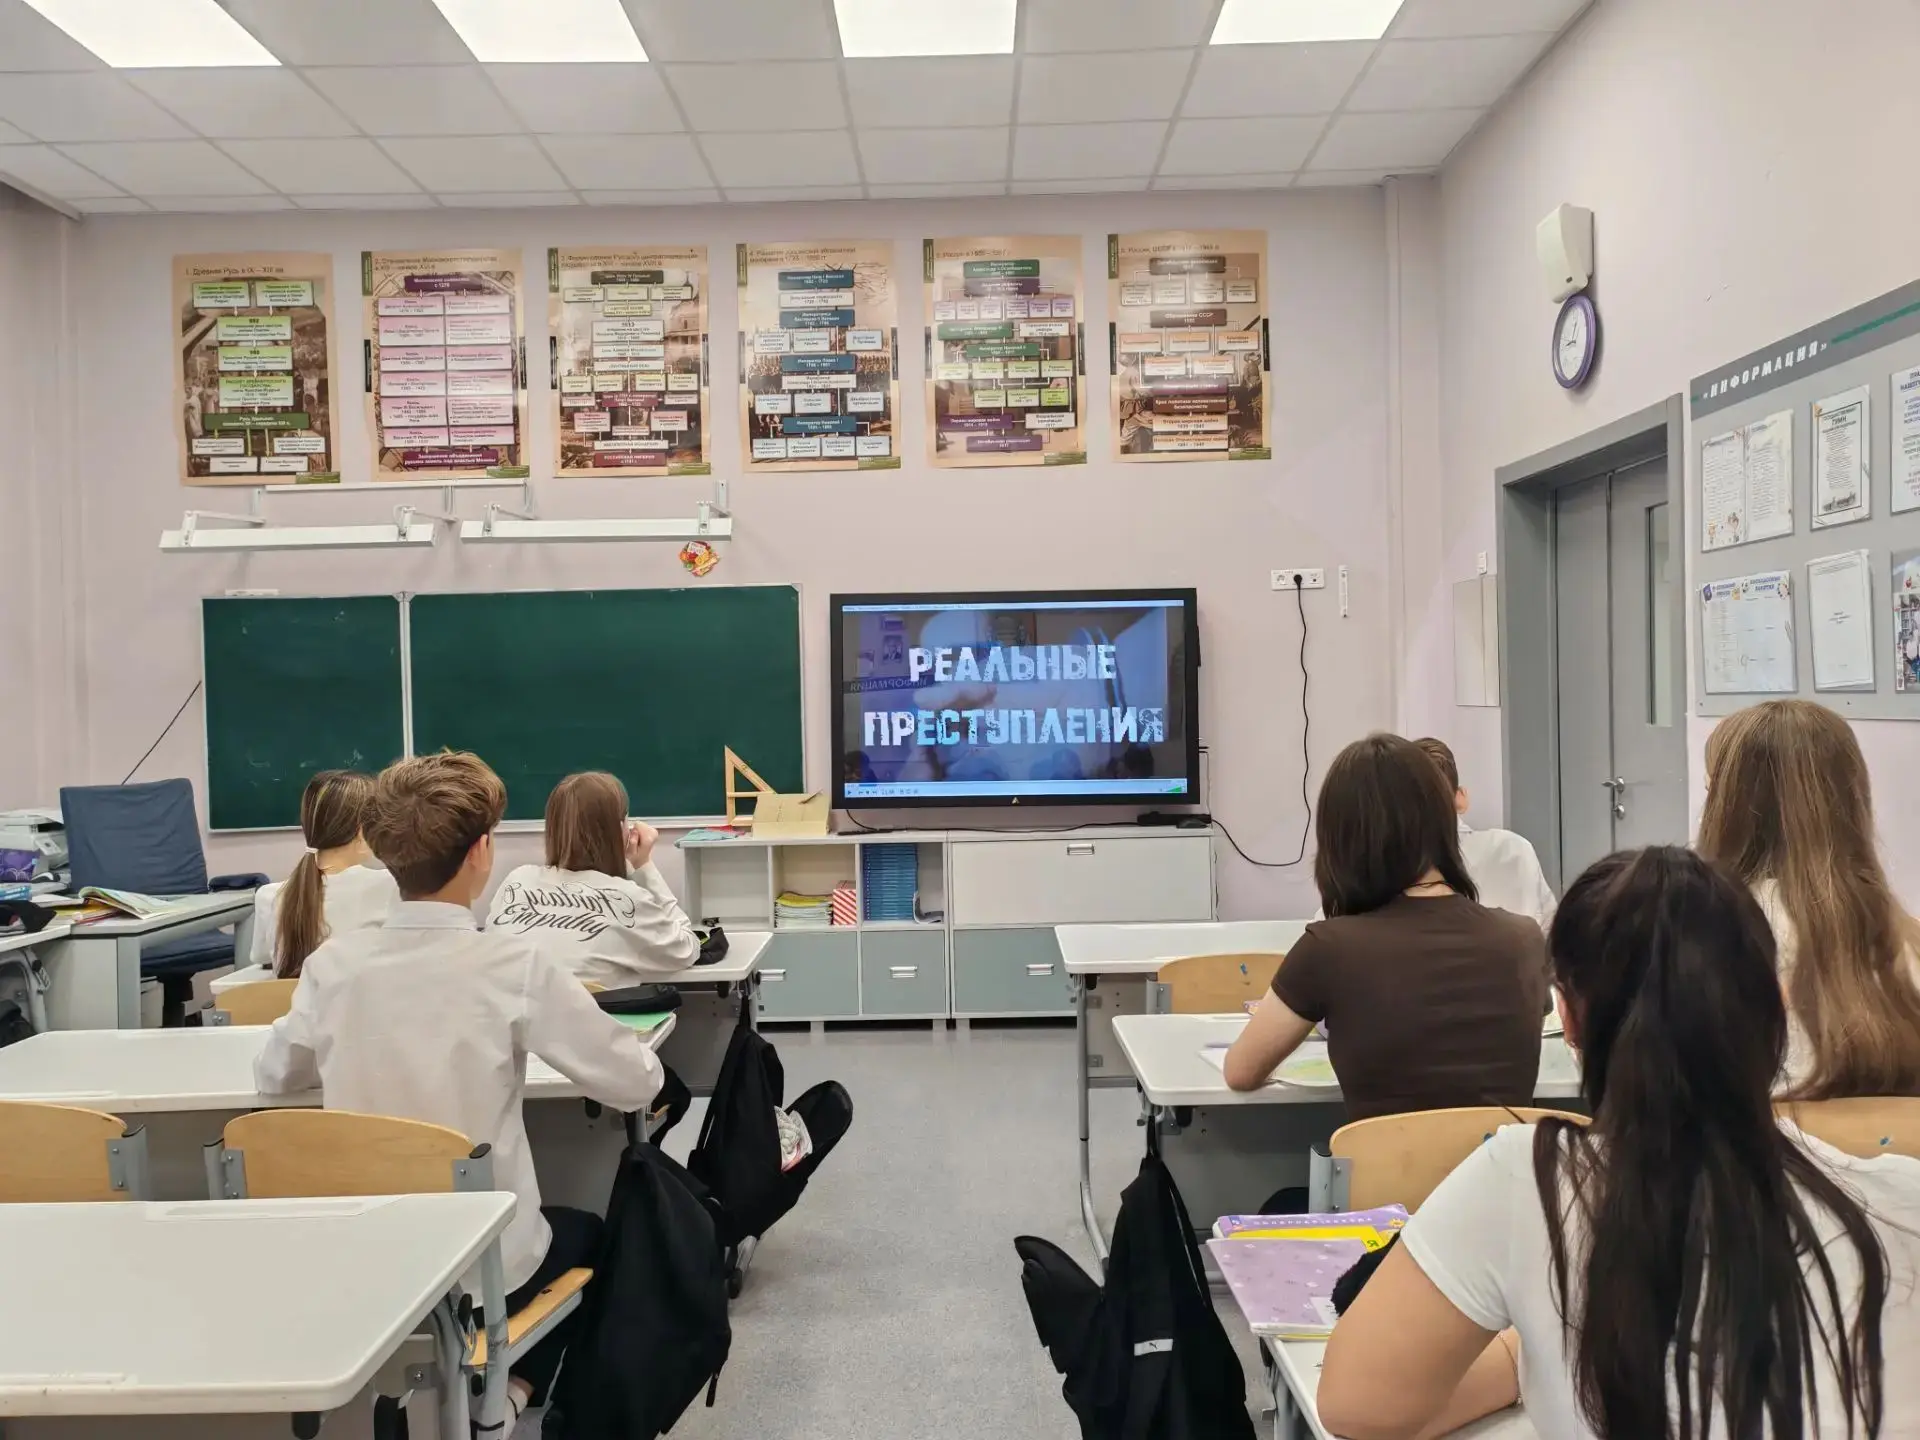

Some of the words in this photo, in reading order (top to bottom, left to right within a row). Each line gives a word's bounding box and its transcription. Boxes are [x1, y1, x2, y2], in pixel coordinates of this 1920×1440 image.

[908, 645, 1117, 683] РЕАЛЬНЫЕ
[864, 706, 1165, 746] ПРЕСТУПЛЕНИЯ
[493, 903, 610, 942] Empathy
